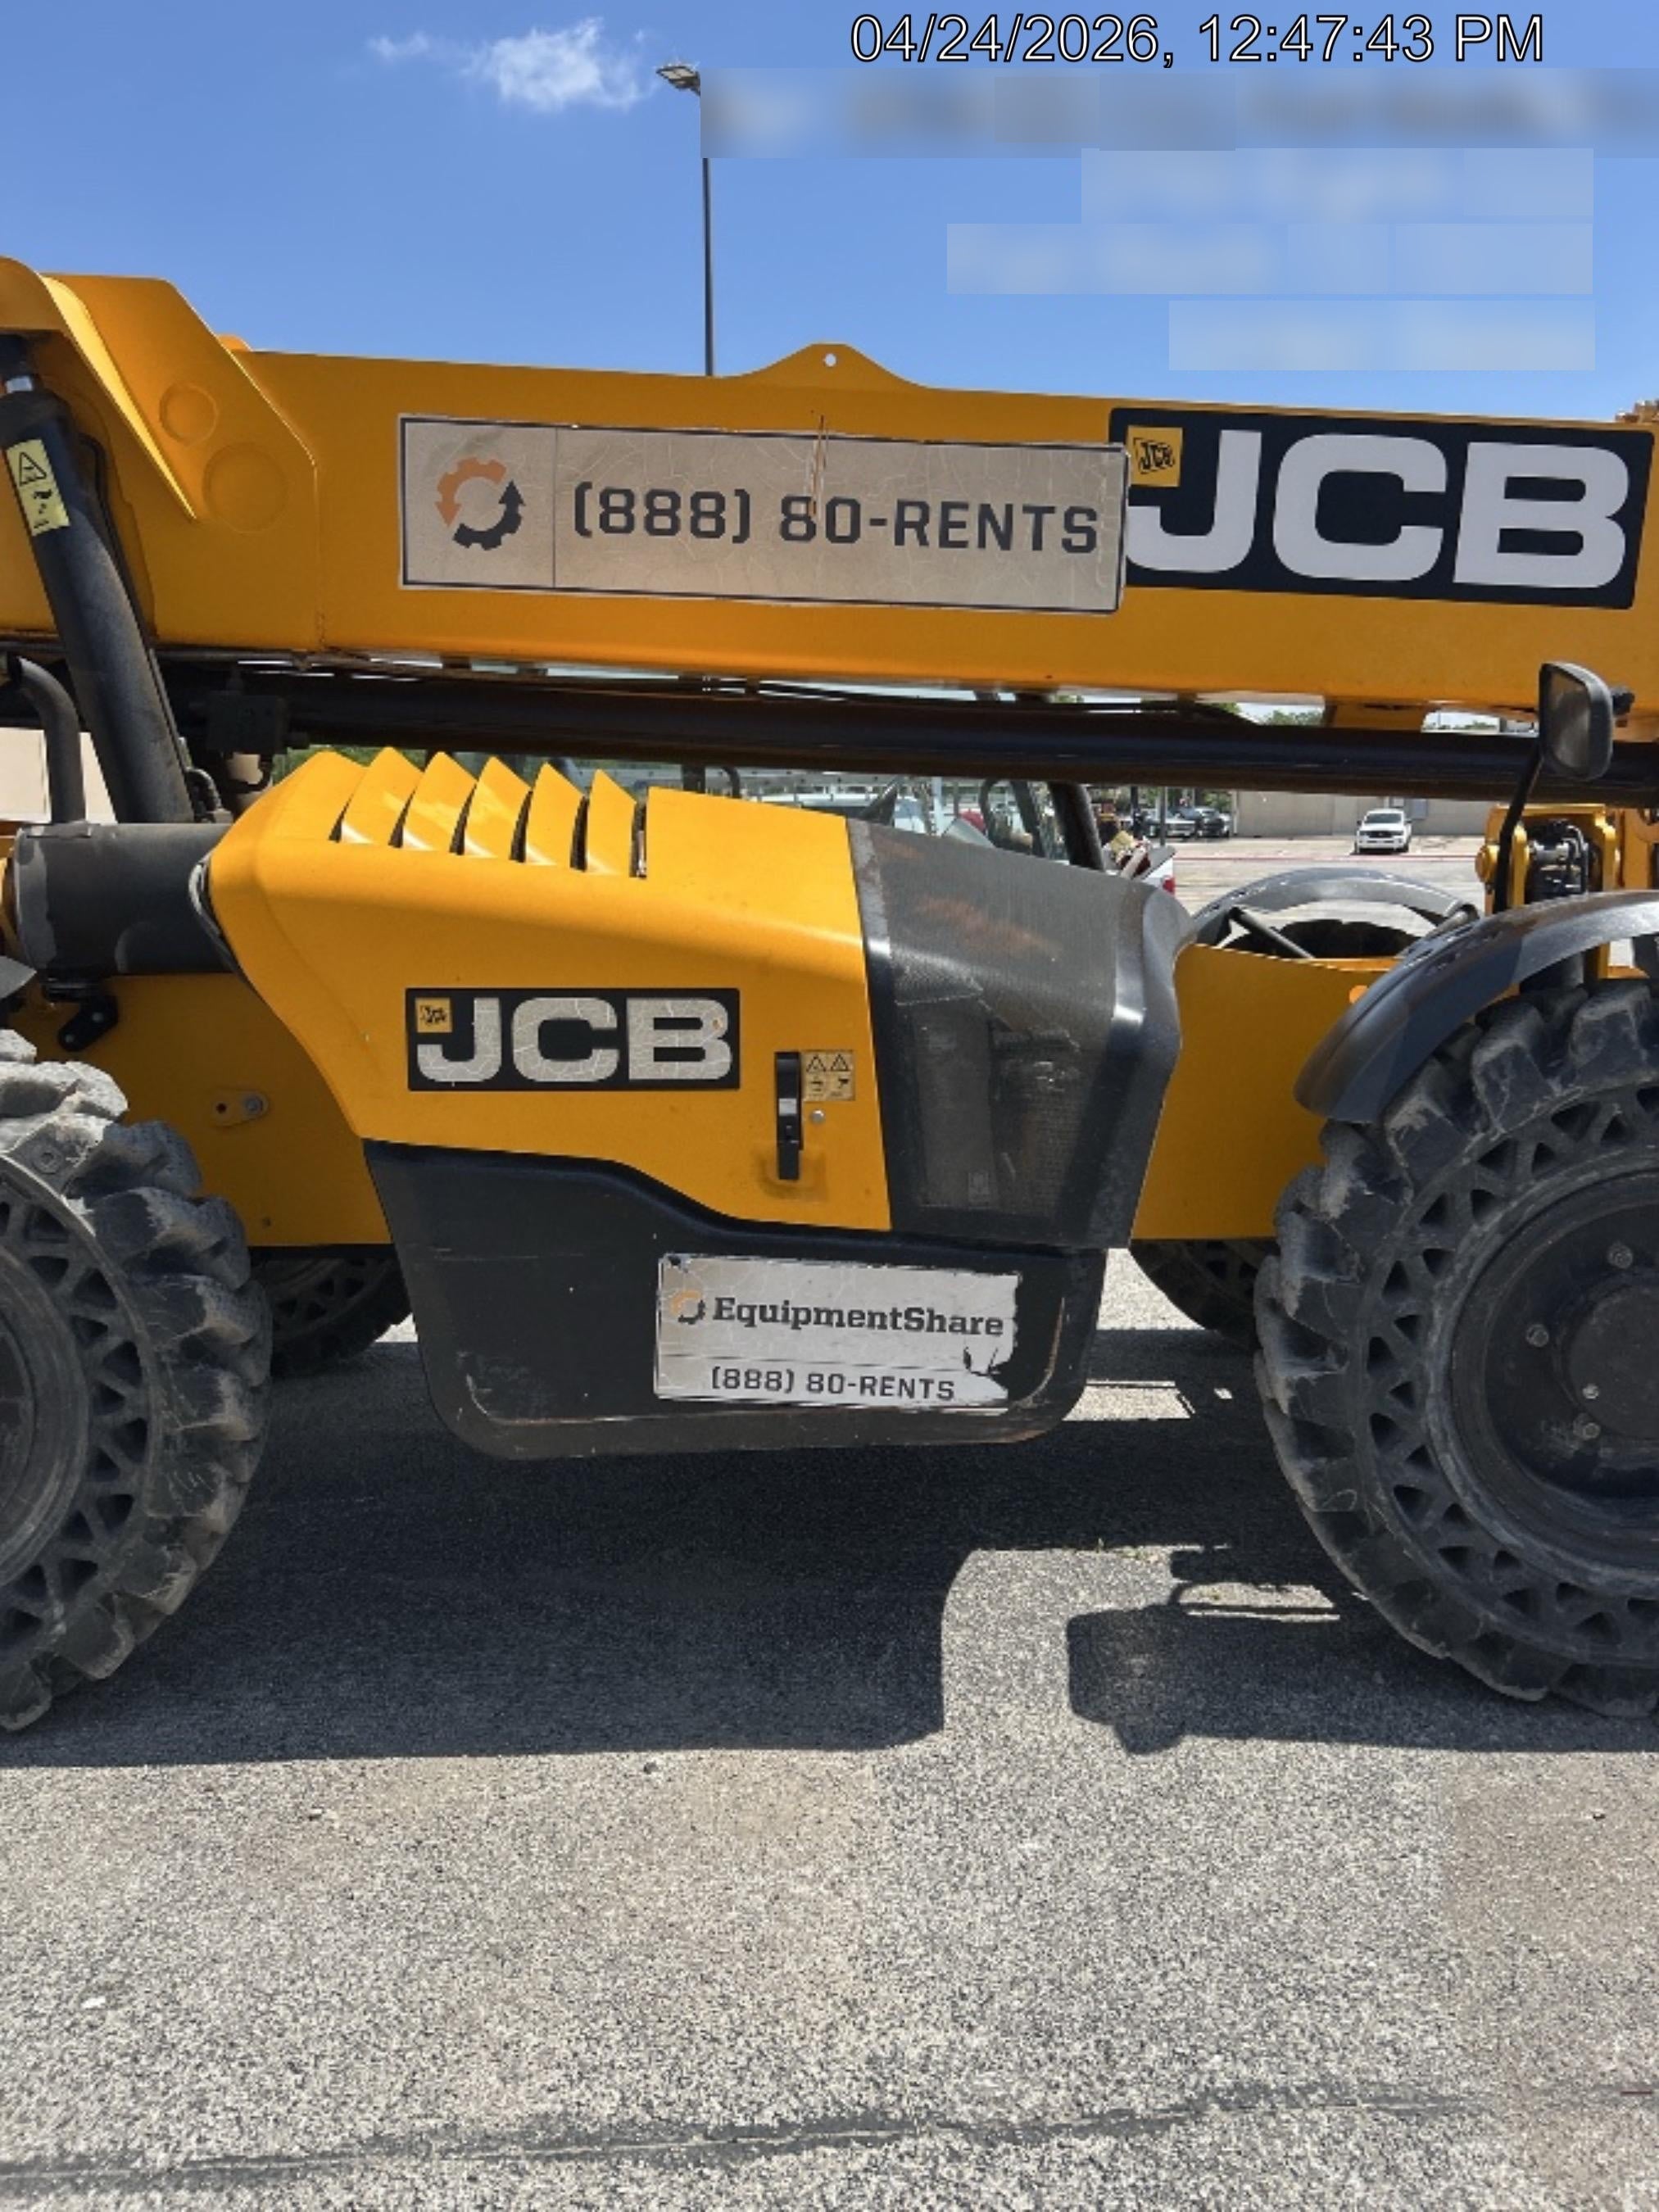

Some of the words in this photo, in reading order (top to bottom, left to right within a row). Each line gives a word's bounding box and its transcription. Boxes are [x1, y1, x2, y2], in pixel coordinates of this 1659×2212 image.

[574, 482, 751, 545] (888)
[778, 495, 1098, 555] 80-RENTS
[1126, 429, 1630, 588] JCB
[416, 997, 733, 1082] JCB
[712, 1296, 1004, 1335] EquipmentShare
[711, 1366, 795, 1391] (888)
[805, 1372, 955, 1399] 80-RENTS
